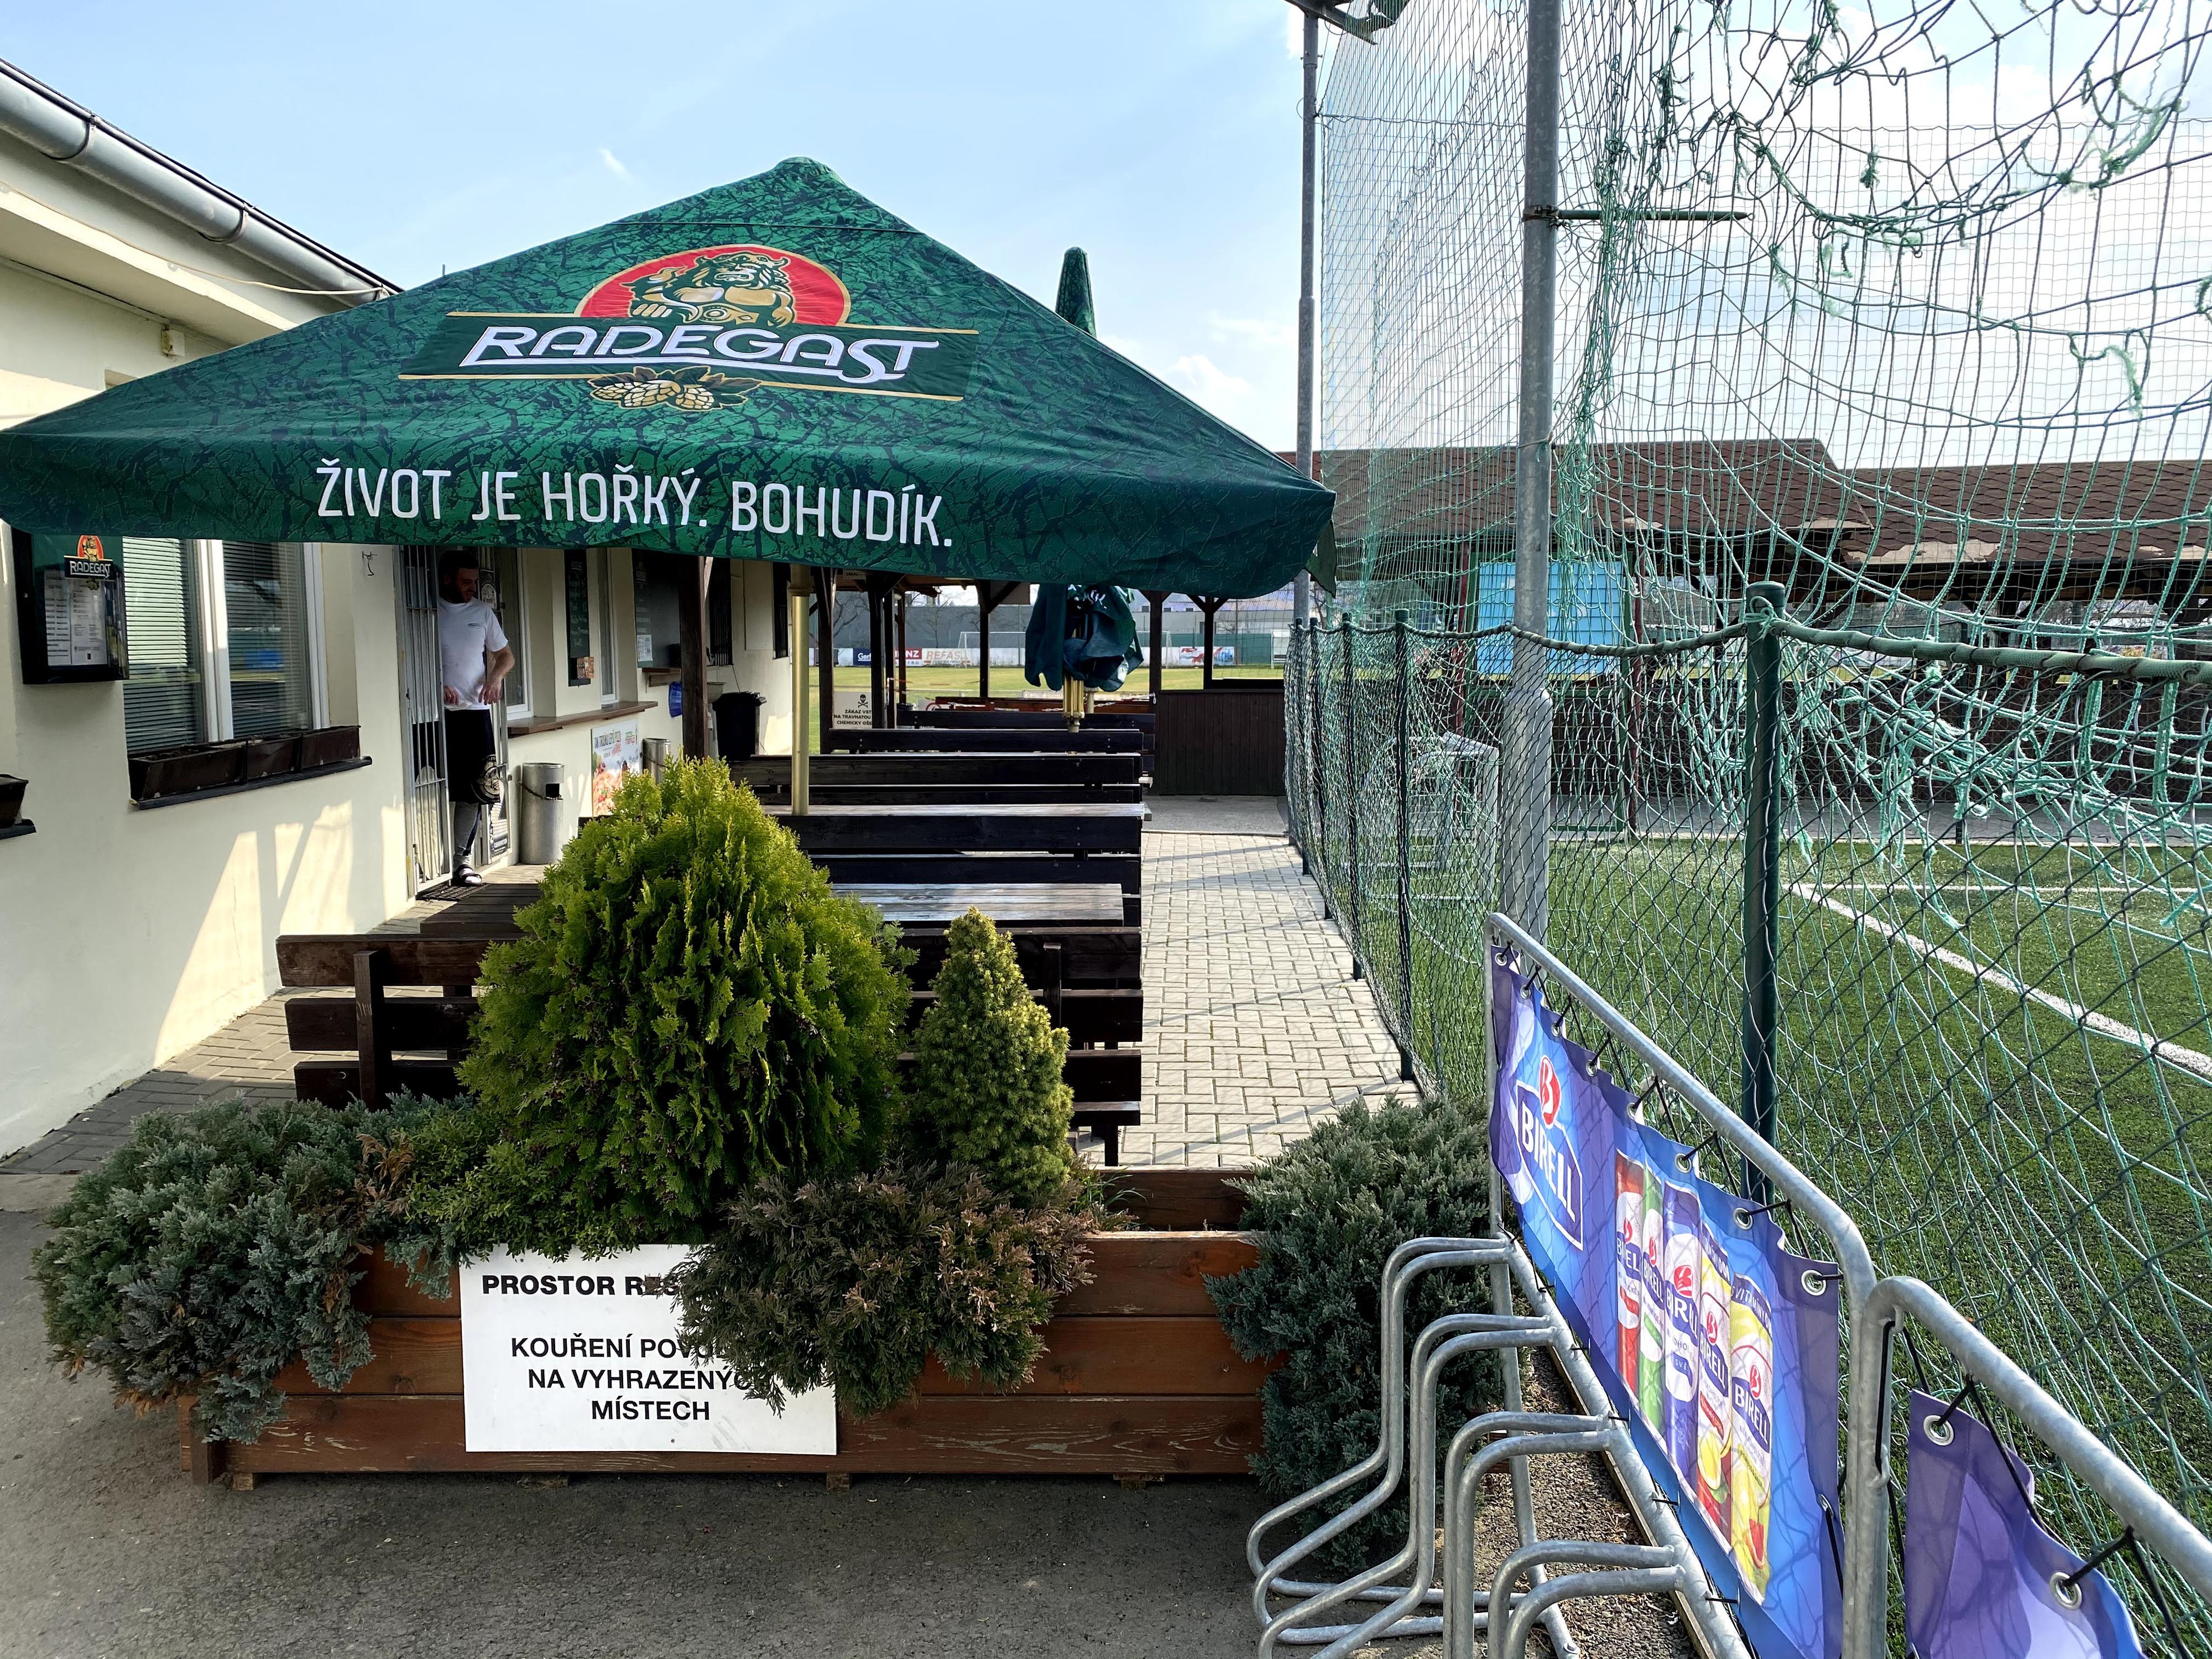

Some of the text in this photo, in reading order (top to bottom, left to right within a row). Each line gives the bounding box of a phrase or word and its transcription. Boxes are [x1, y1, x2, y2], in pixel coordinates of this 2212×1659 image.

[458, 324, 940, 384] RADEGAST
[316, 457, 952, 547] ŽIVOT JE HOŘKÝ. BOHUDÍK.
[70, 560, 111, 578] RADEGAST
[1522, 1100, 1575, 1223] BIRELL
[482, 1275, 615, 1296] PROSTOR
[1644, 1257, 1663, 1302] BIRELL
[511, 1333, 632, 1358] KOUŘENÍ
[1700, 1331, 1725, 1389] BIRELL
[528, 1365, 751, 1390] NA VYHRAZENÝC
[592, 1396, 710, 1421] MÍSTECH
[1735, 1383, 1768, 1445] BIRELL
